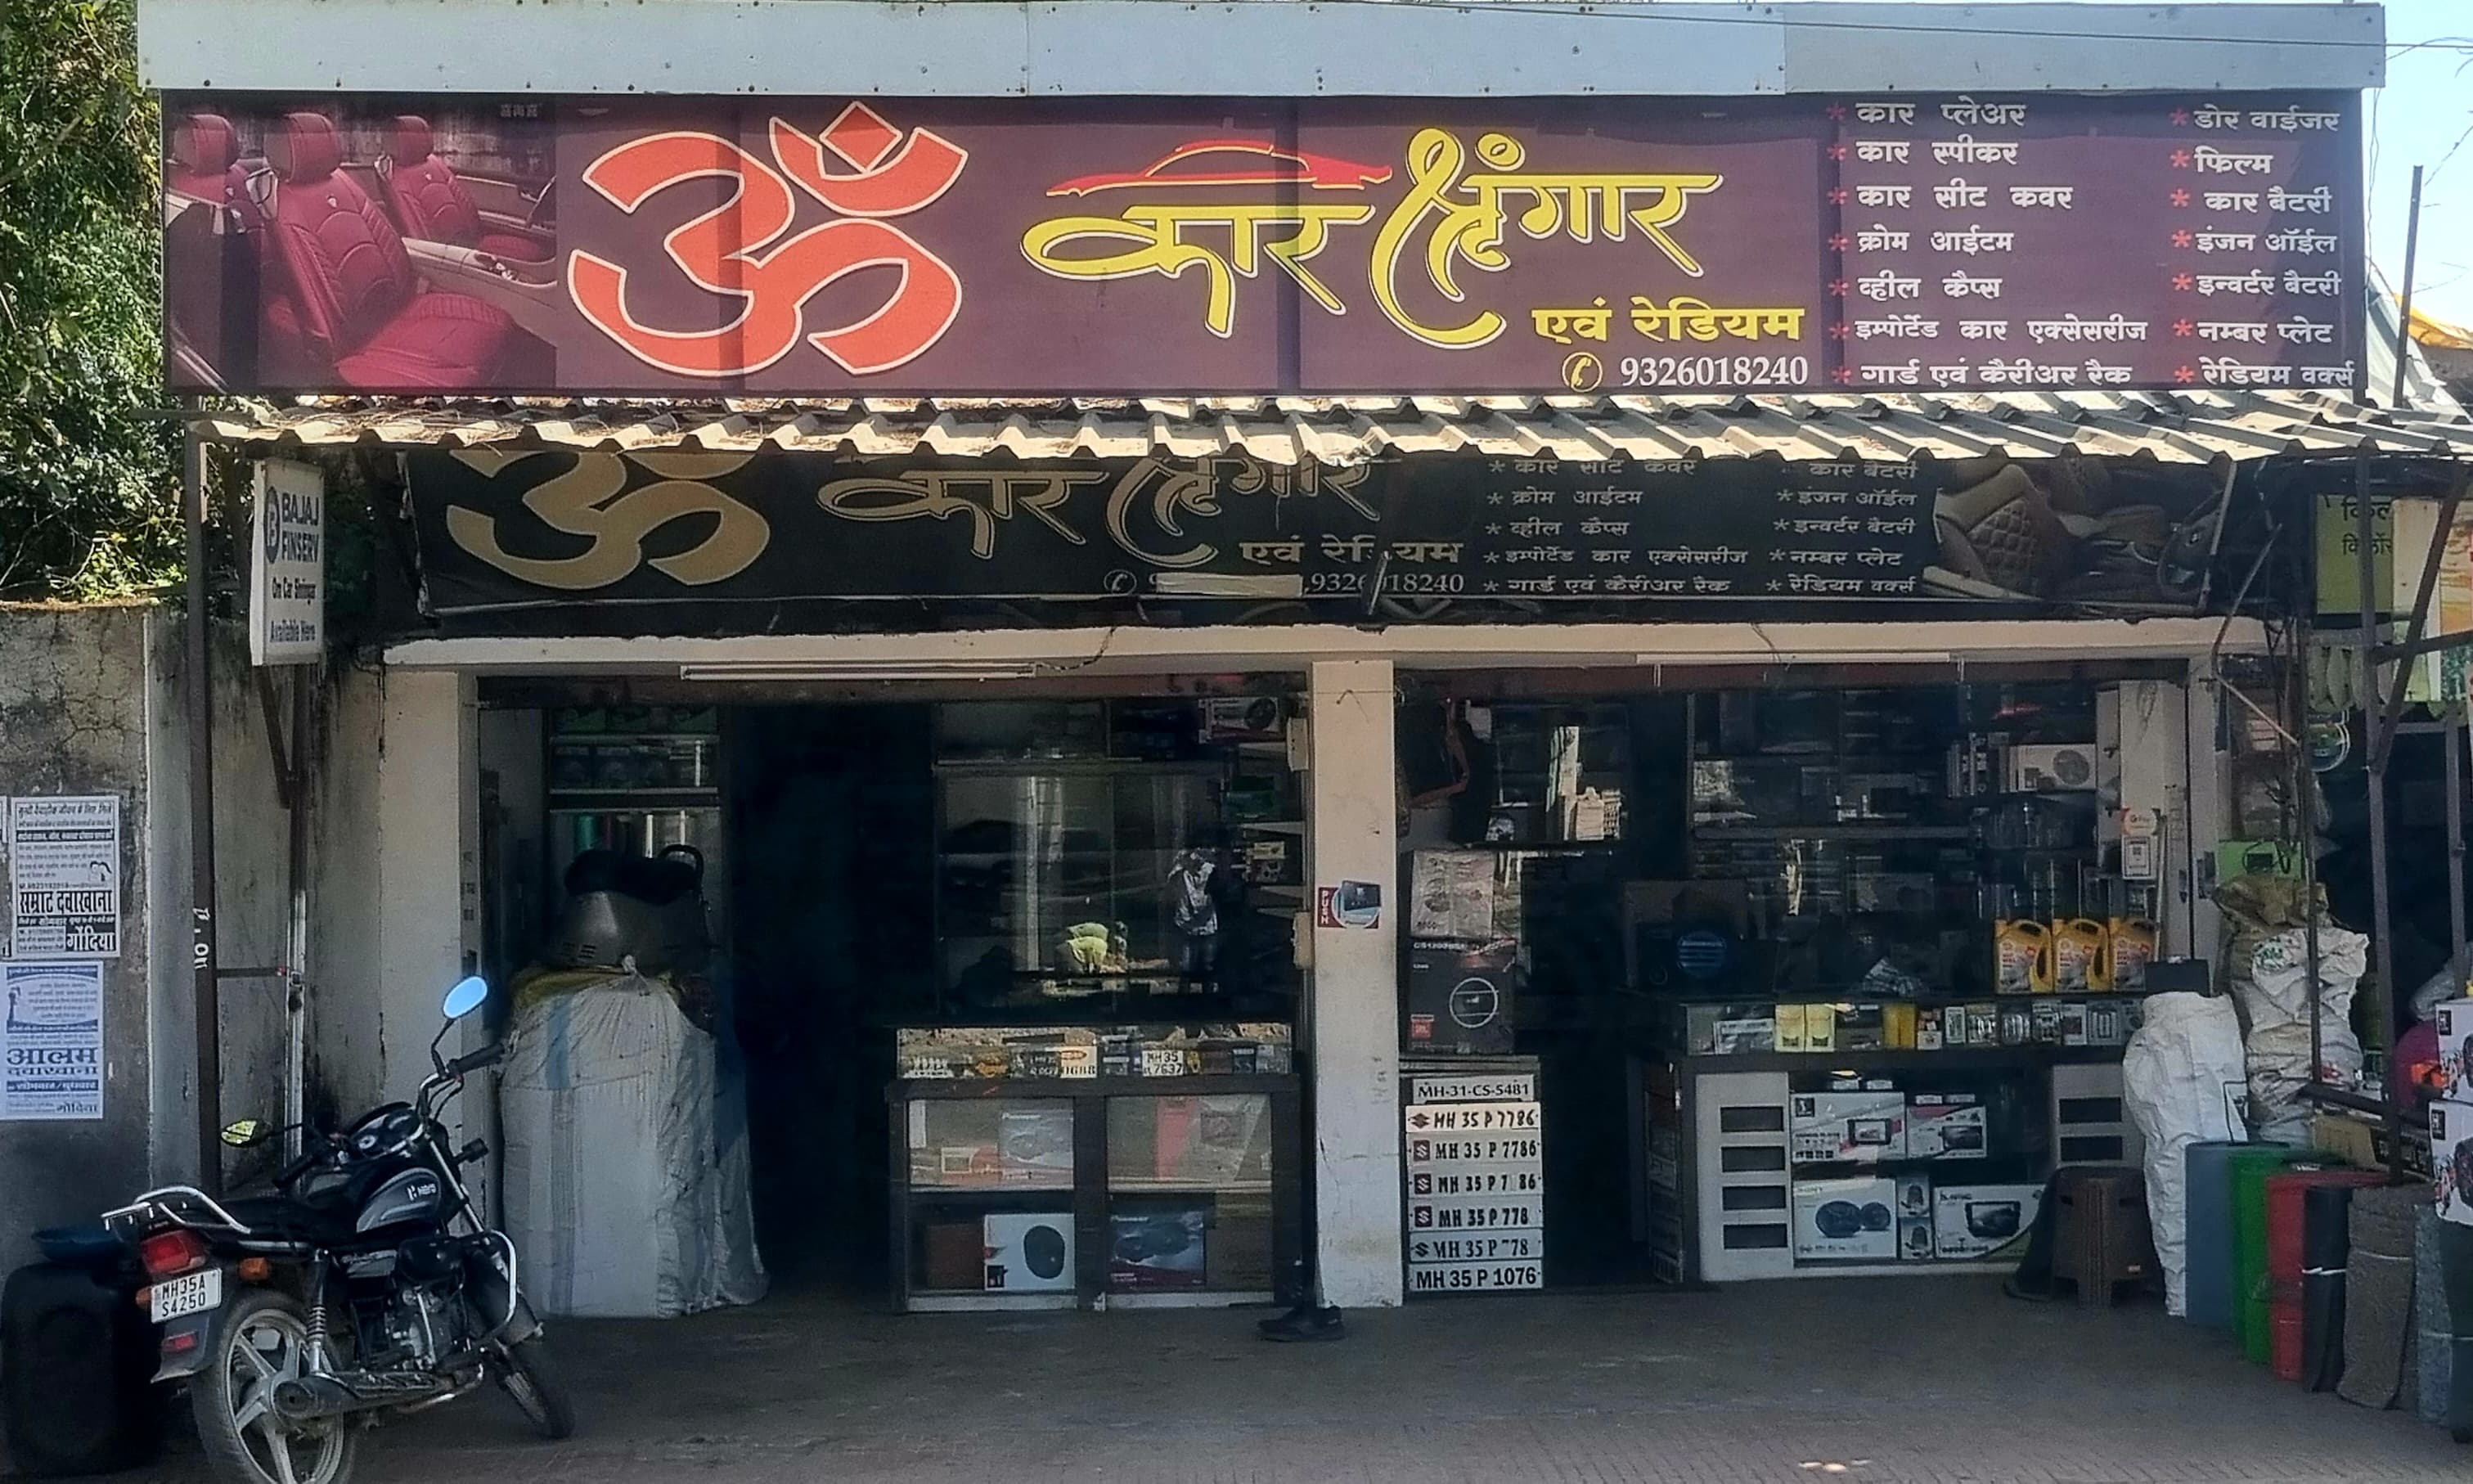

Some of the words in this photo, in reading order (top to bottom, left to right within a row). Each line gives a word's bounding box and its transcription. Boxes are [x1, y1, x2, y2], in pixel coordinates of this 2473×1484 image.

[1855, 103, 1915, 125] कार
[1940, 97, 2026, 128] प्लेअर
[2193, 104, 2240, 130] डोर
[2249, 104, 2340, 133] वाईजर
[1855, 141, 1911, 164] कार
[1931, 133, 2019, 166] स्पीकर
[2193, 146, 2274, 175] फिल्म
[1855, 185, 1913, 209] कार
[1933, 177, 1988, 209] सीट
[2009, 187, 2074, 209] कवर
[2203, 192, 2259, 214] कार
[2267, 185, 2333, 214] बैटरी
[1856, 223, 1910, 252] क्रोम
[1930, 224, 2015, 254] आईटम
[2195, 225, 2257, 254] इंजन
[2264, 227, 2338, 255] ऑईल
[1857, 269, 1922, 300] व्हील
[1941, 269, 2003, 299] कैप्स
[2196, 268, 2276, 296] इन्वर्टर
[2282, 269, 2343, 296] बैटरी
[1531, 297, 1612, 344] एवं
[1631, 296, 1805, 342] रेडियम
[1855, 313, 1940, 340] इम्पोर्टेड
[1958, 320, 2008, 341] कार
[2026, 313, 2149, 344] एक्सेसरीज
[2196, 322, 2268, 344] नम्बर
[2276, 315, 2334, 344] प्लेट
[1621, 356, 1809, 387] 9326018240
[1860, 358, 1921, 385] गार्ड
[1928, 357, 1970, 388] एवं
[1977, 358, 2078, 386] कैरीअर
[2084, 358, 2134, 386] रैक
[2198, 356, 2292, 386] रेडियम
[2300, 359, 2356, 389] वर्क्स
[1809, 462, 1856, 479] कार
[281, 491, 320, 527] BAJAJ
[1511, 485, 1556, 506] क्रोम
[1572, 486, 1643, 506] आईटम
[1509, 516, 1563, 538] व्हील
[1580, 516, 1630, 537] कैप्स
[1867, 516, 1917, 535] बैटरी
[1239, 533, 1306, 565] एवं
[1590, 549, 1632, 565] कार
[1789, 551, 1849, 567] नम्बर
[1856, 546, 1904, 567] प्लेट
[1507, 576, 1556, 594] गार्ड
[1563, 577, 1597, 596] एवं
[1692, 578, 1732, 595] रैक
[1787, 574, 1864, 596] रेडियम
[20, 891, 54, 915] सम्राट
[56, 889, 113, 915] दवाखाना
[7, 1047, 98, 1066] आलम
[1434, 1112, 1456, 1130] MH
[1461, 1111, 1479, 1128] 35
[1484, 1111, 1493, 1128] P
[1497, 1109, 1535, 1129] 7786
[1435, 1142, 1459, 1160] MH
[1464, 1141, 1481, 1159] 35
[1488, 1141, 1497, 1158] P
[1502, 1140, 1536, 1158] 7786
[1437, 1176, 1459, 1194] MH
[1465, 1175, 1482, 1192] 35
[1487, 1175, 1496, 1191] P
[1437, 1208, 1463, 1228] MH
[1467, 1208, 1486, 1227] 35
[1488, 1207, 1498, 1226] P
[1433, 1240, 1461, 1259] MH
[1465, 1239, 1484, 1258] 35
[1486, 1239, 1497, 1257] P
[162, 1275, 206, 1301] MH35A
[1416, 1270, 1446, 1288] MH
[1450, 1269, 1472, 1288] 35
[1477, 1268, 1489, 1286] P
[1493, 1266, 1536, 1286] 1076
[162, 1291, 206, 1317] S4250
